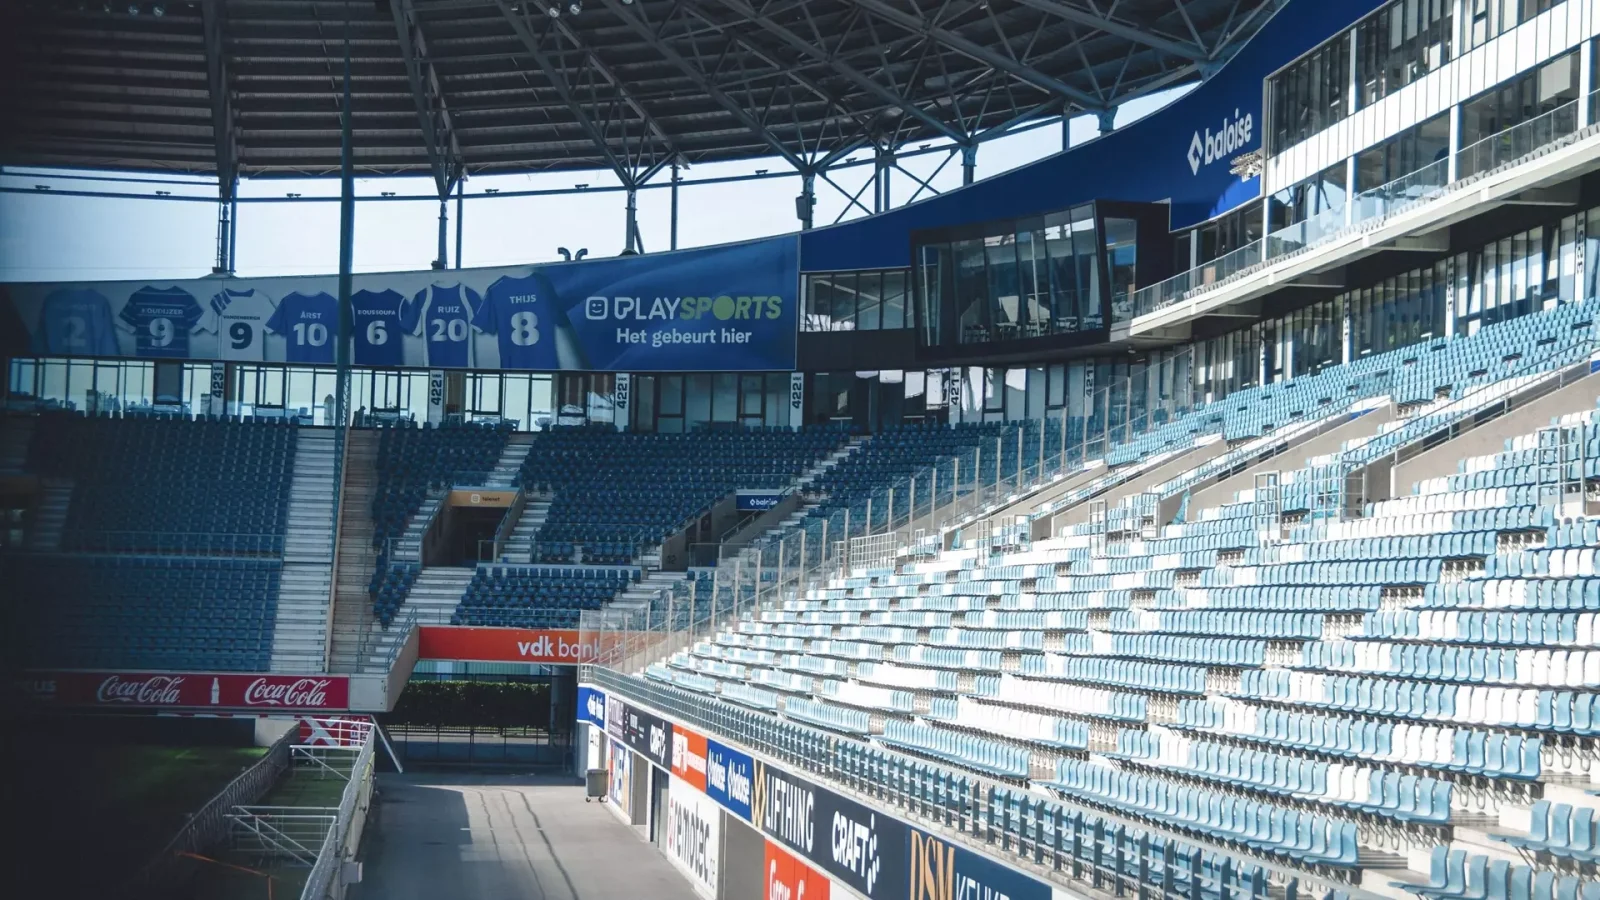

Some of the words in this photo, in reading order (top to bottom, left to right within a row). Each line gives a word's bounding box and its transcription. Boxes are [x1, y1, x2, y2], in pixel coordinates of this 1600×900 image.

[1204, 107, 1252, 166] baloise
[437, 305, 460, 314] RUIZ
[509, 294, 537, 305] THIJS
[61, 316, 87, 347] 2
[149, 317, 175, 347] 9
[229, 322, 254, 350] 9
[293, 322, 328, 347] 10
[366, 320, 389, 345] 6
[430, 318, 468, 342] 20
[510, 311, 540, 346] 8
[616, 328, 647, 344] Het
[652, 328, 716, 347] gebeurt
[721, 328, 752, 344] hier
[212, 372, 224, 399] 423
[431, 379, 443, 406] 422
[616, 382, 628, 409] 422
[791, 382, 802, 409] 422
[950, 376, 960, 406] 421
[517, 635, 555, 658] vdk
[558, 636, 601, 658] bank
[97, 675, 185, 704] Coca-Cola
[244, 676, 331, 706] Coca-Cola
[732, 761, 750, 806] baloise
[765, 773, 814, 853] LIFTHING
[831, 810, 870, 877] CRAFT
[909, 829, 956, 900] DSM
